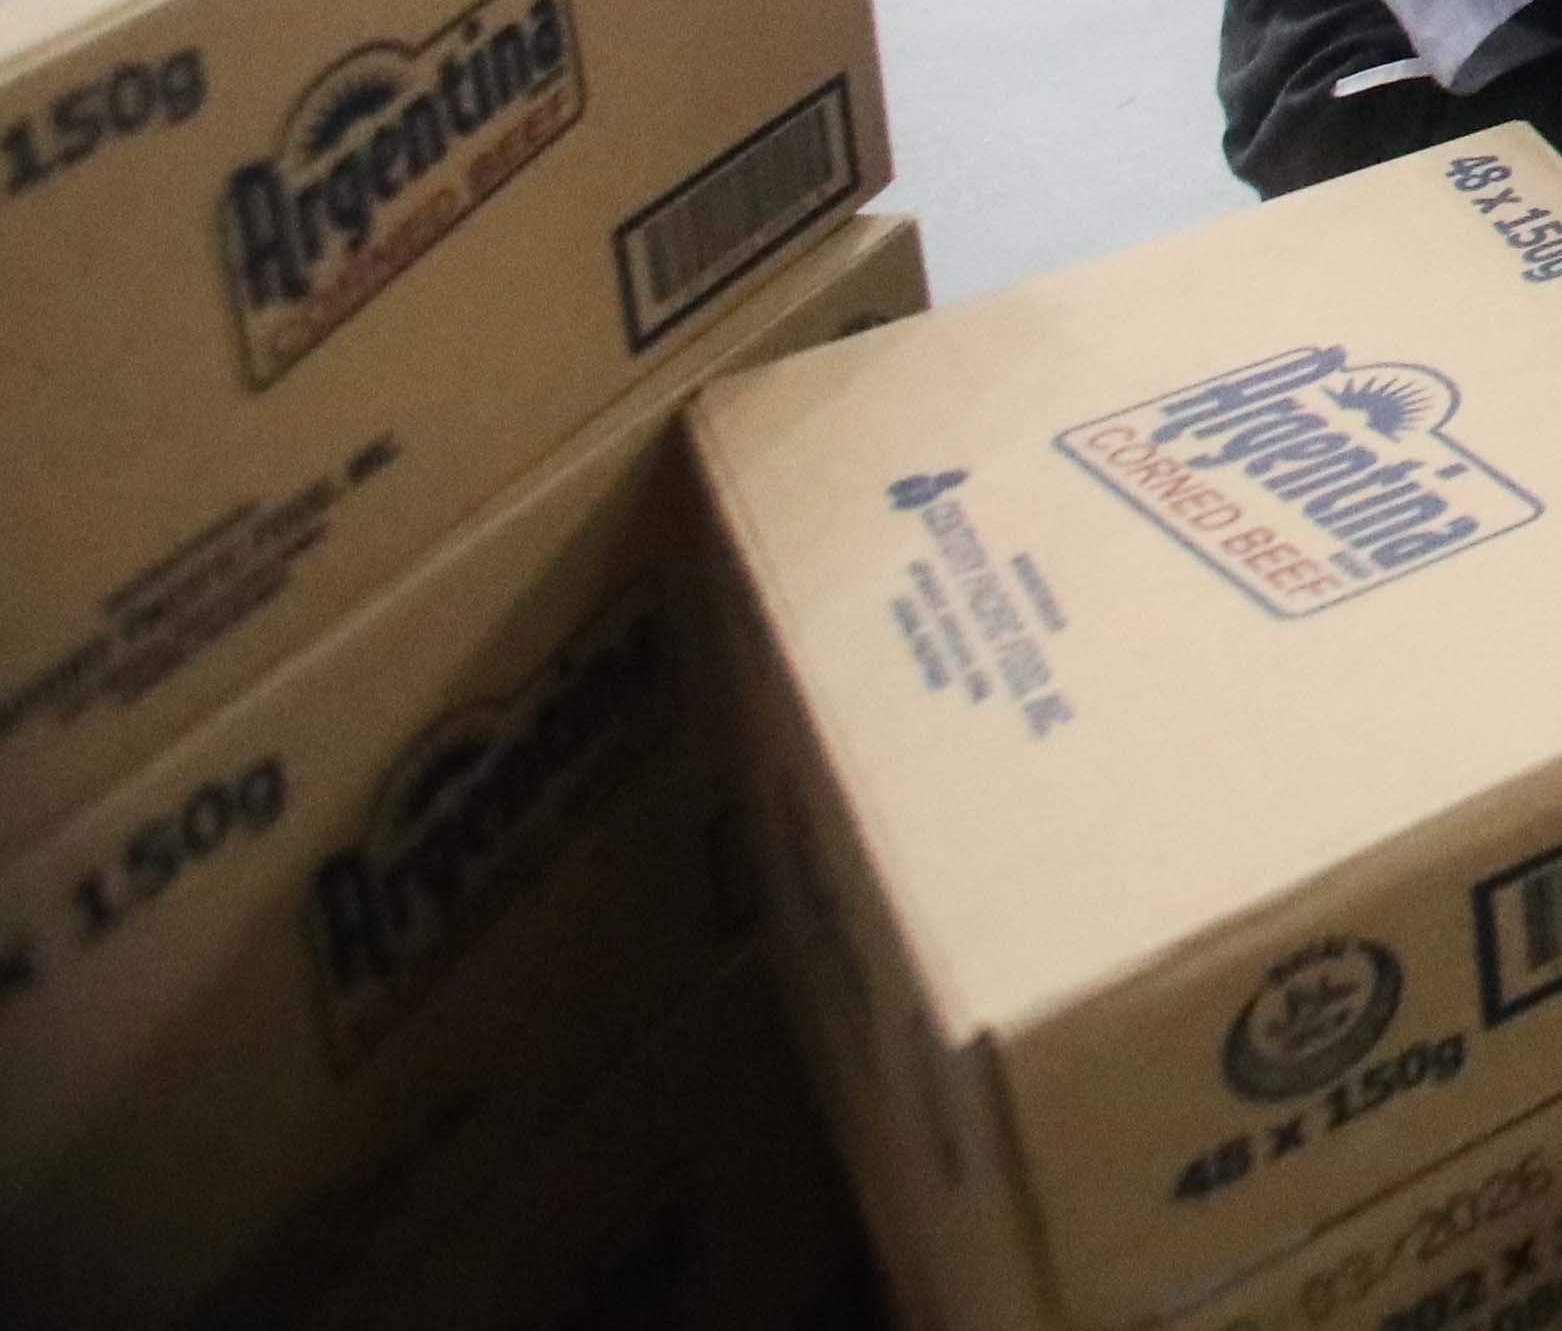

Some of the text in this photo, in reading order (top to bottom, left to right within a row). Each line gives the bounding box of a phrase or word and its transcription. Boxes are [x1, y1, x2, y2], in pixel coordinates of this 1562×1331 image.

[1444, 154, 1513, 193] 48
[1471, 186, 1522, 215] x
[1149, 343, 1482, 572] Argentina
[1087, 423, 1345, 597] CORNED BEEF
[1325, 1034, 1470, 1131] 150g
